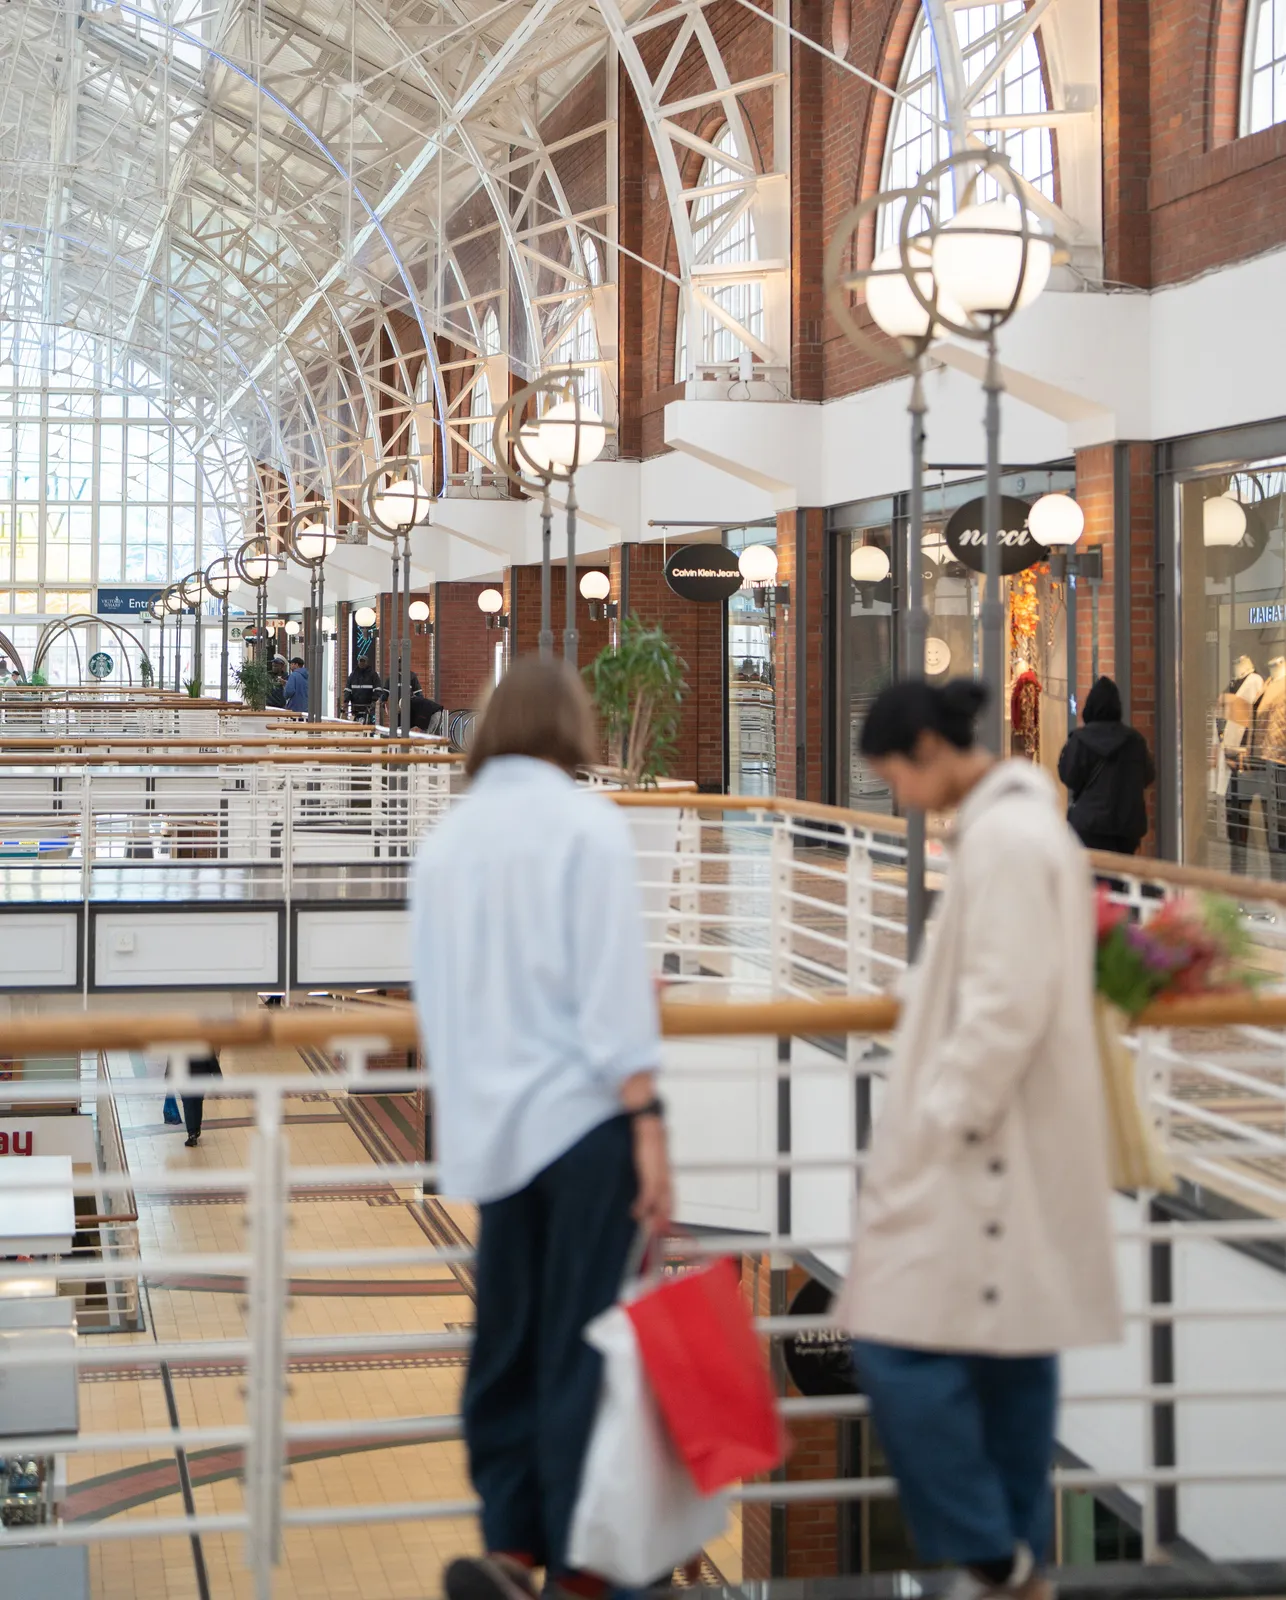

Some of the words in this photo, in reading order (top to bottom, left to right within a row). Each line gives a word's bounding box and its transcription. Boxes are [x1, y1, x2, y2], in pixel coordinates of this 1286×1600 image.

[672, 568, 697, 577] Calvin
[697, 568, 716, 578] Klein
[716, 569, 740, 578] Jeans
